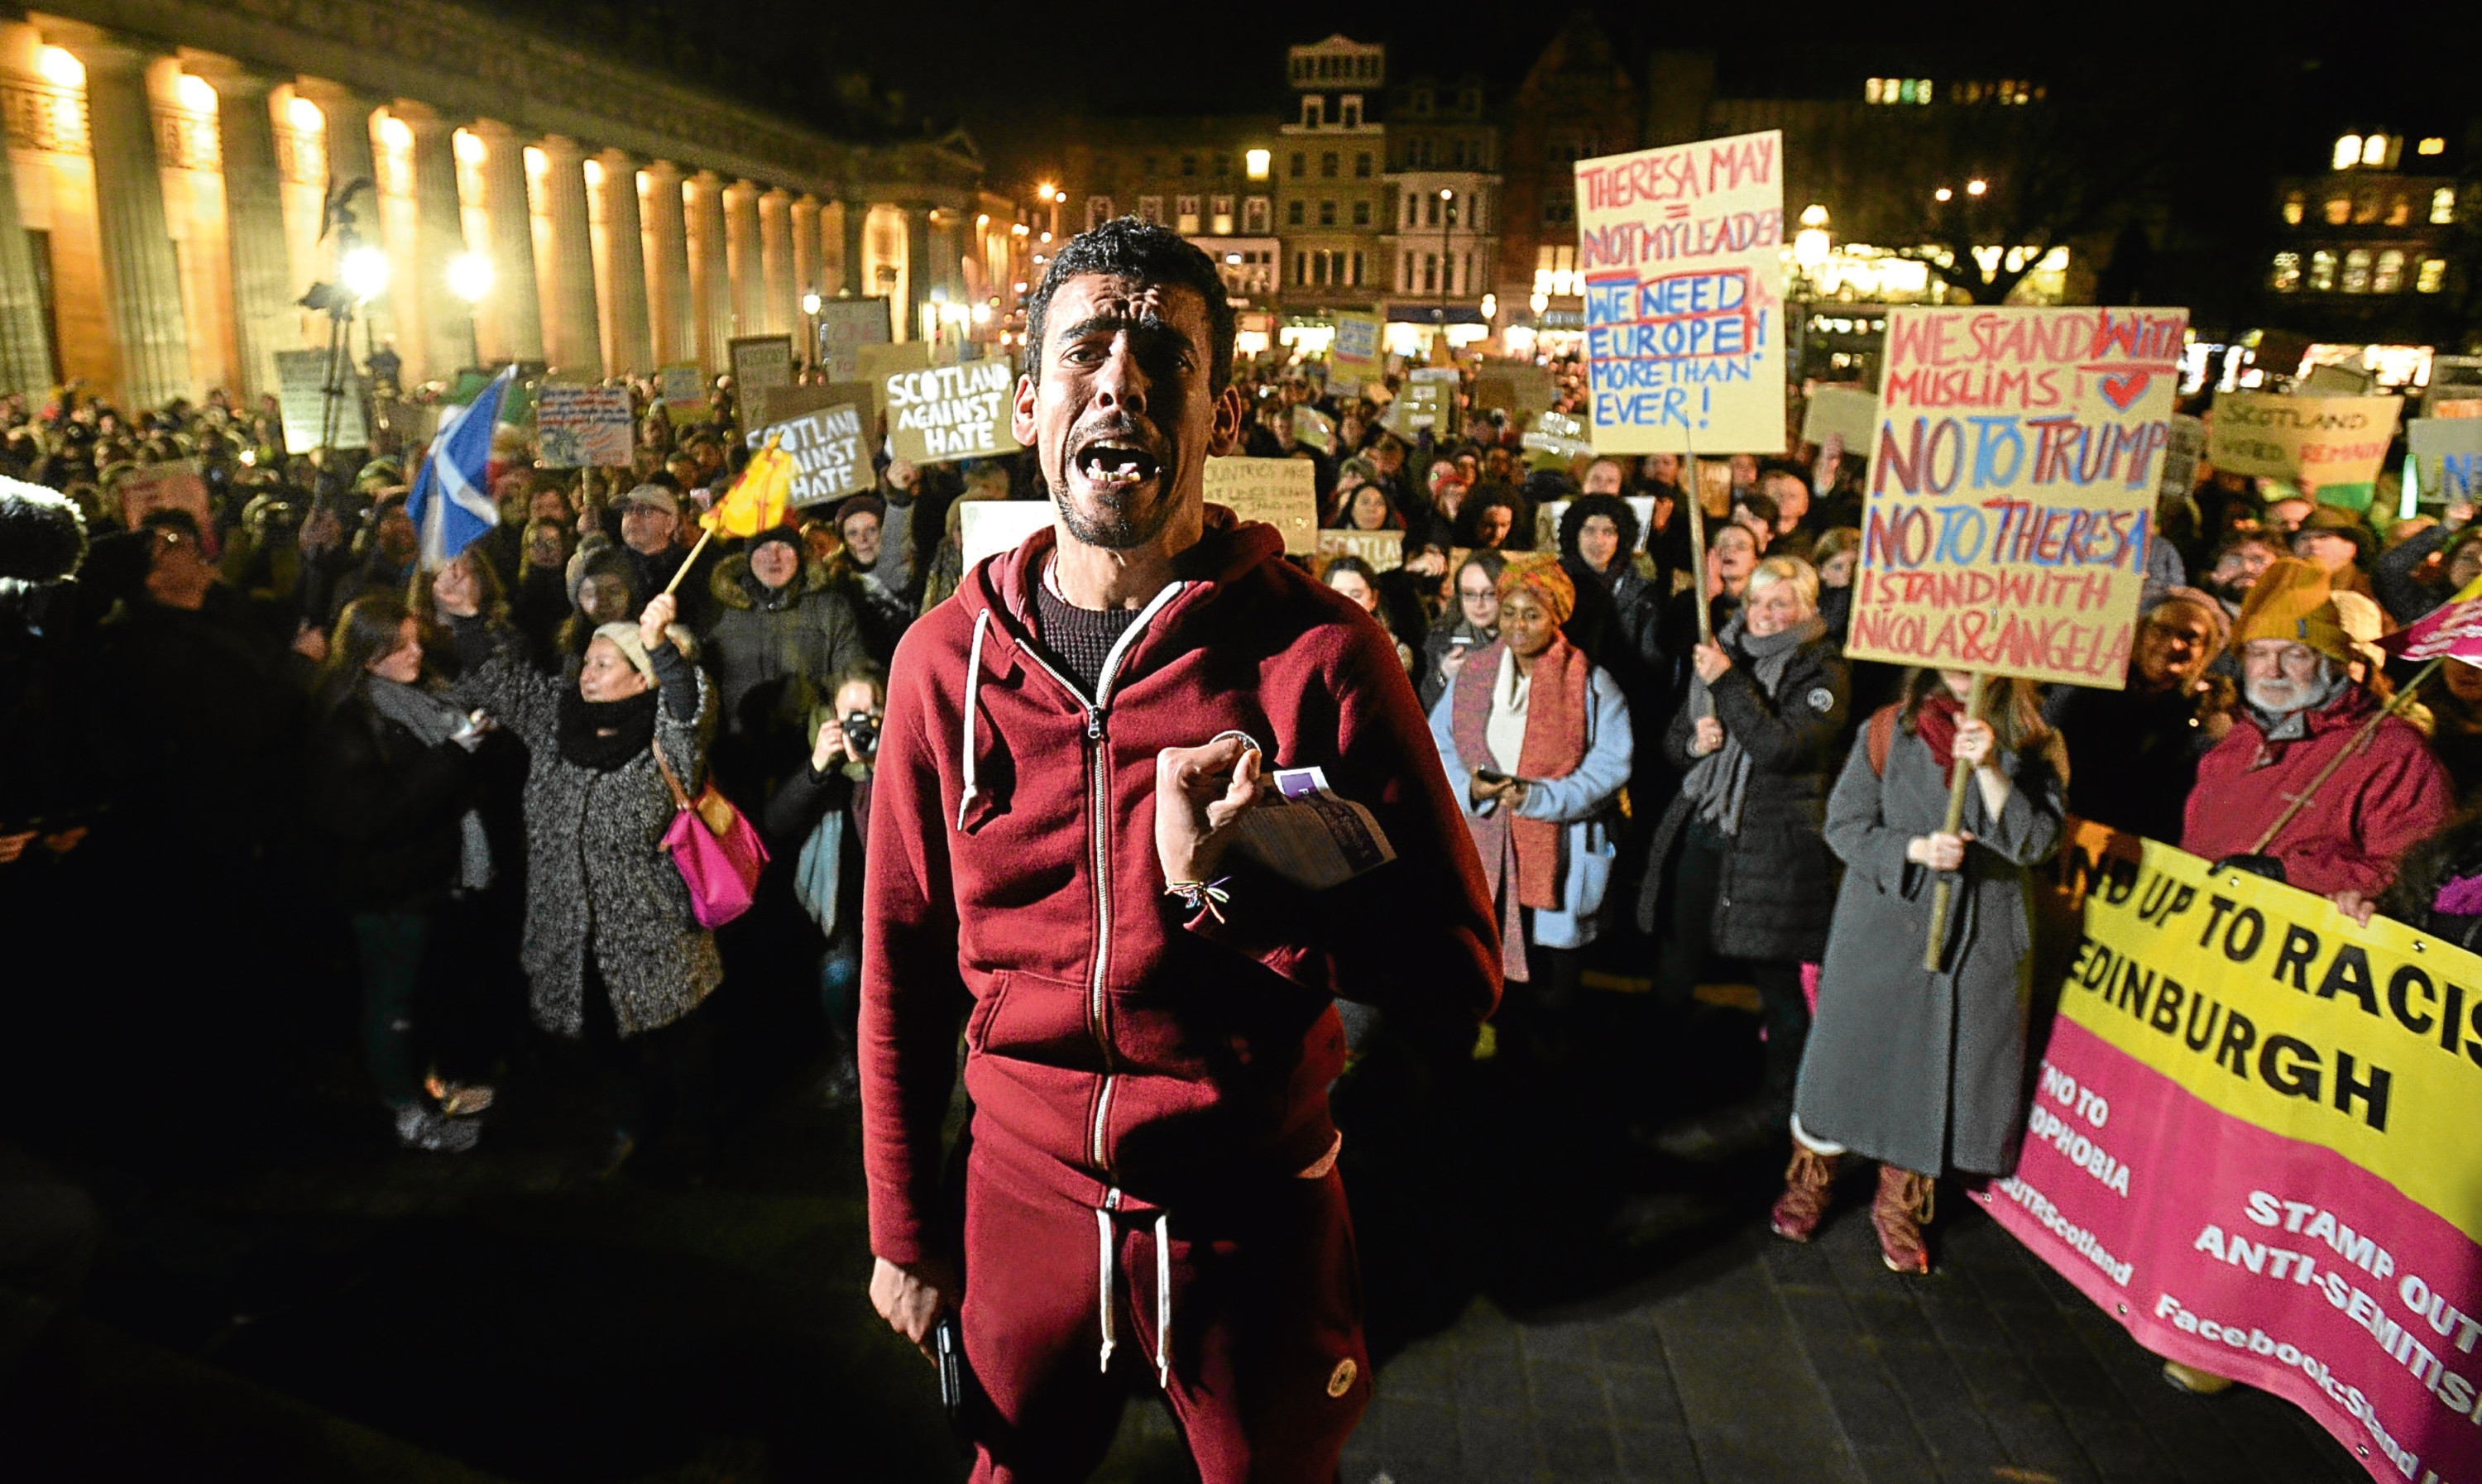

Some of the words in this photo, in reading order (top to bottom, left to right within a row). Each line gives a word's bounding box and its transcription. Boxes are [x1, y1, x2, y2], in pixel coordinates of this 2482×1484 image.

[1577, 150, 1701, 212] THERESA
[1708, 137, 1773, 193] MAY
[1587, 279, 1632, 325] WE
[1641, 275, 1744, 316] NEED
[1892, 313, 1962, 366] WE
[1963, 312, 2096, 364] STAND
[887, 362, 1011, 407] SCOTLAND
[1591, 360, 1663, 390] MORE
[1664, 356, 1751, 383] THAN
[898, 391, 1003, 431] AGAINST
[923, 421, 996, 456] HATE
[1872, 416, 1966, 497] NO
[1966, 414, 2025, 488] TO
[2027, 414, 2170, 490] TRUMP
[790, 464, 853, 501] HATE
[1865, 503, 1934, 572] NO
[1934, 505, 1986, 566] TO
[1981, 496, 2152, 574] THERESA
[1876, 570, 1997, 610] STAND
[1999, 567, 2113, 610] WITH
[2138, 872, 2197, 927] UP
[2199, 897, 2265, 963] TO
[2075, 1086, 2109, 1128] TO
[2029, 1104, 2130, 1198] OPHOBIA
[2245, 1190, 2395, 1281] STAMP
[2398, 1274, 2482, 1355] OUT
